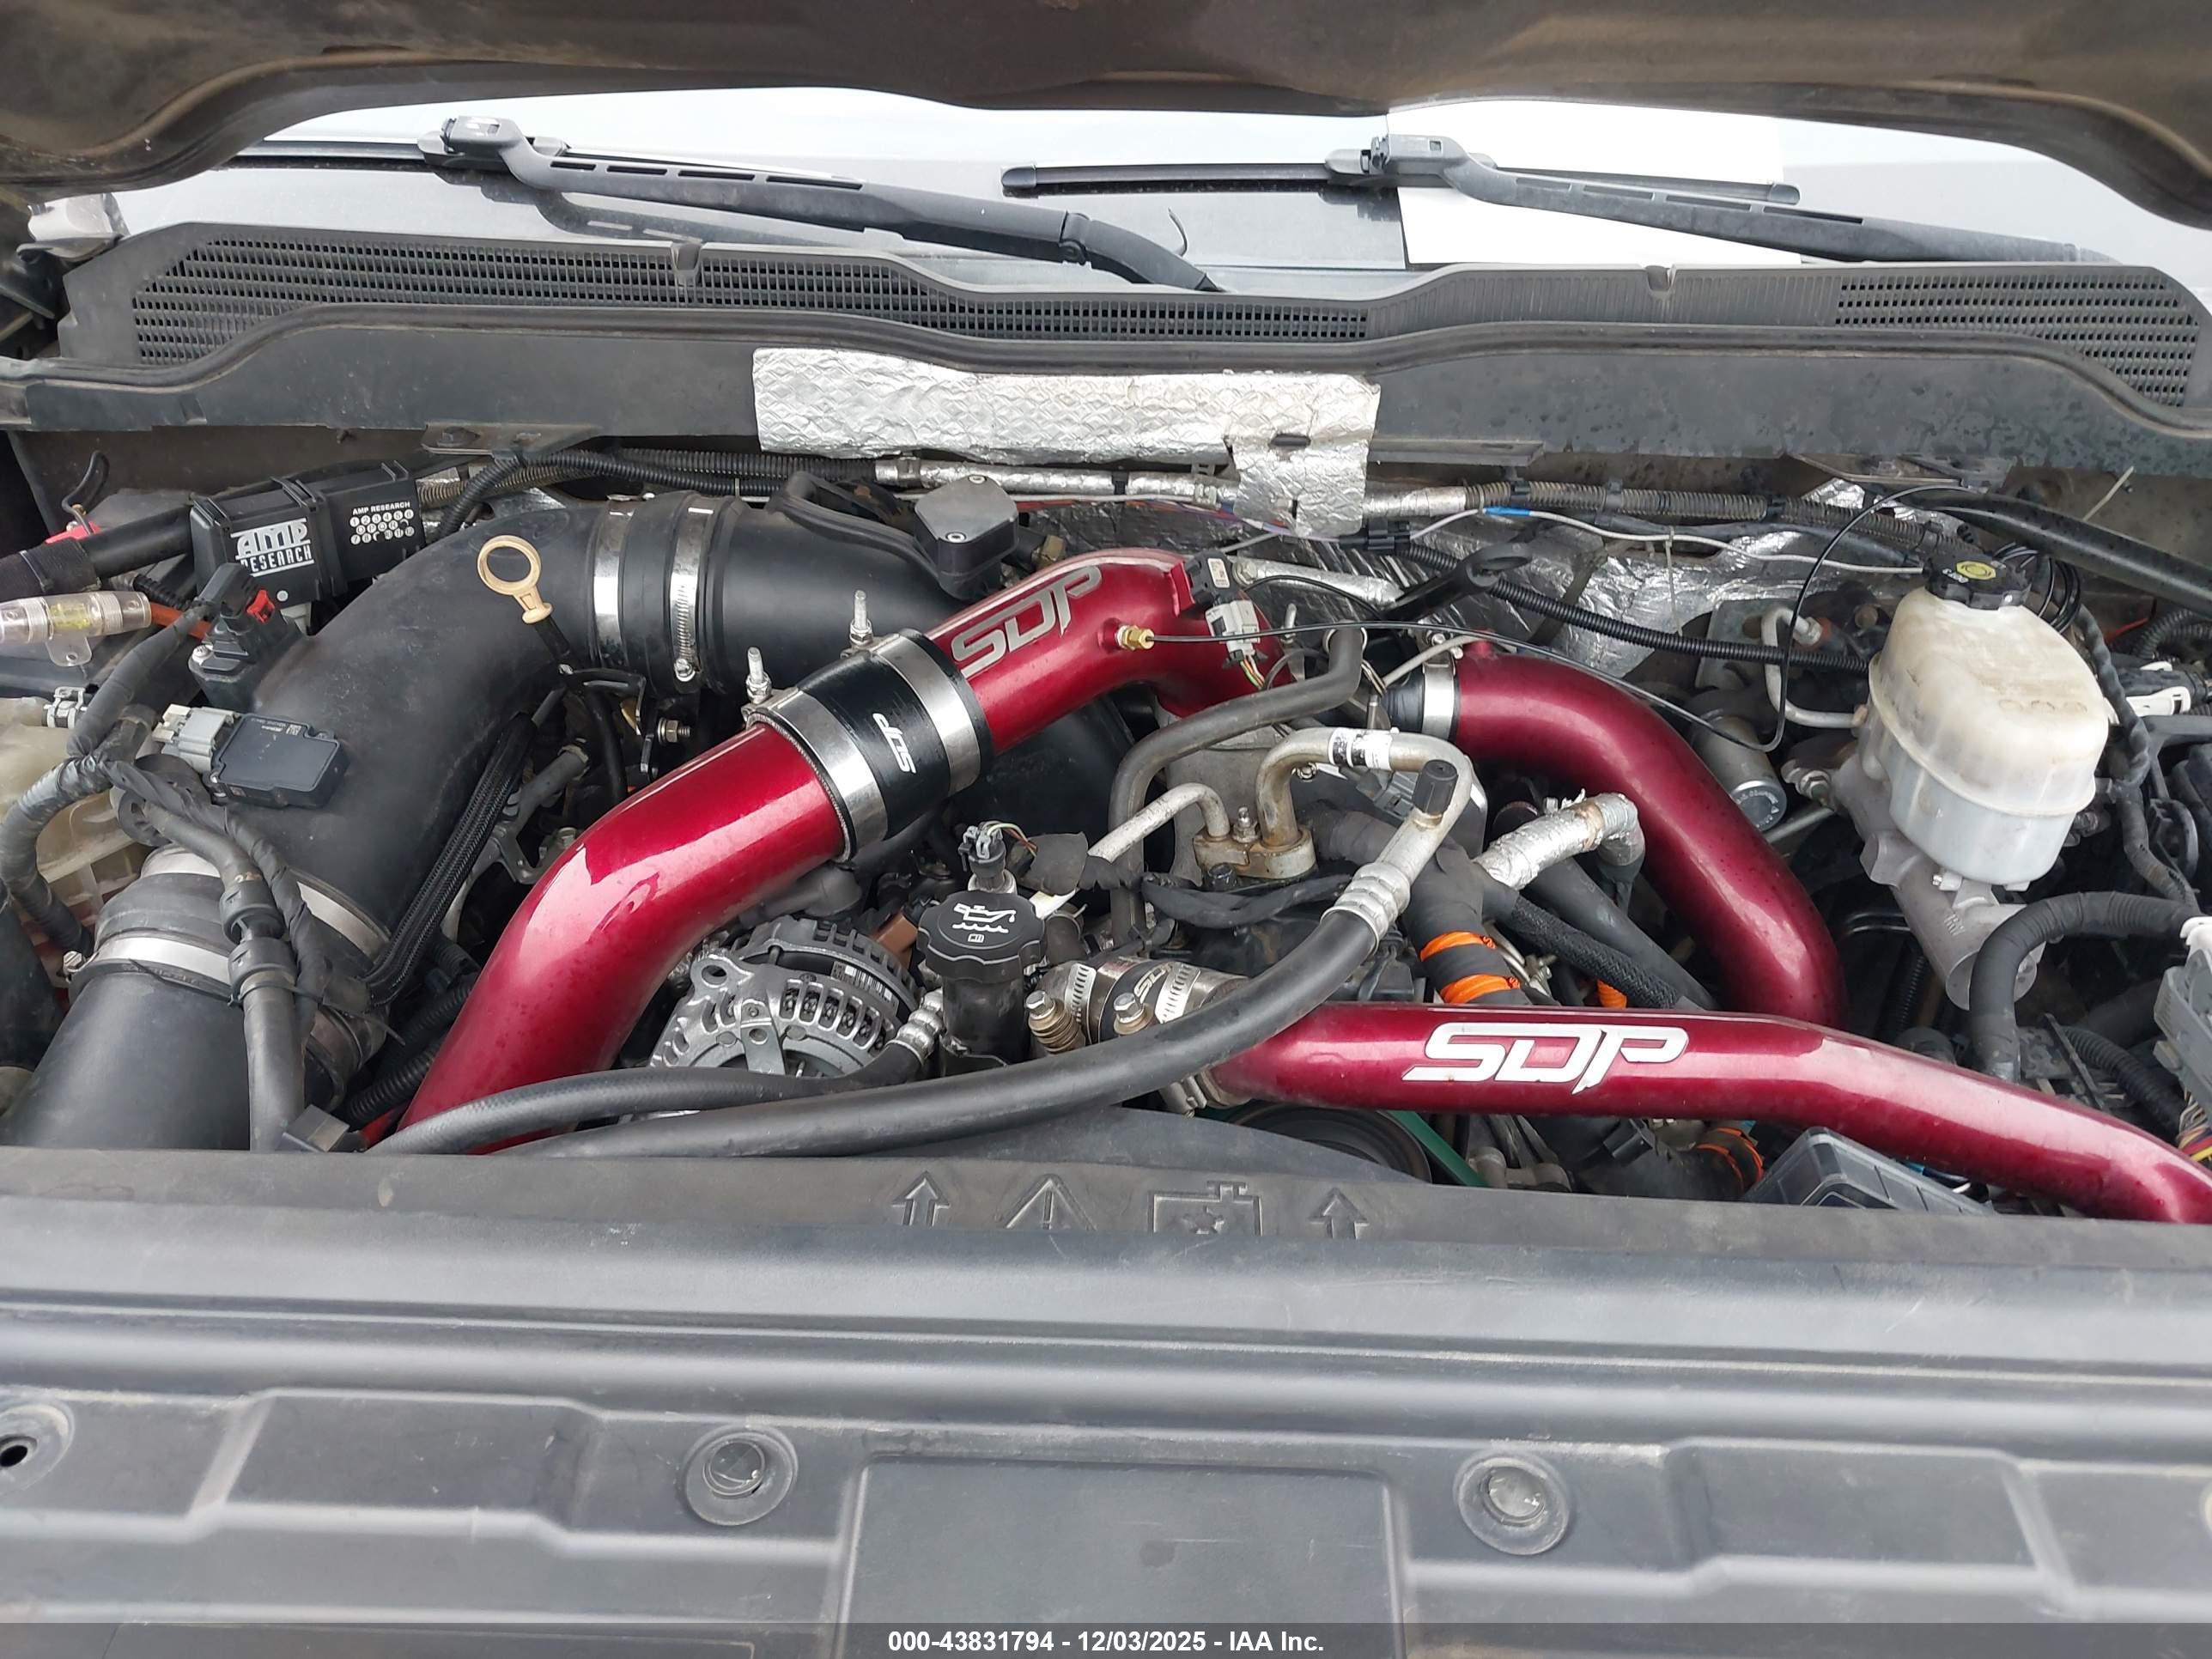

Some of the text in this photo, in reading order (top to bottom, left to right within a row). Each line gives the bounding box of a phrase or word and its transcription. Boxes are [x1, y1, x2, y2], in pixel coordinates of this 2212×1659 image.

[352, 501, 410, 516] AMP RESEARCH
[234, 520, 309, 559] AMP
[951, 566, 1102, 679] SDP
[872, 713, 916, 774] SDP
[1401, 1021, 1690, 1095] SDP
